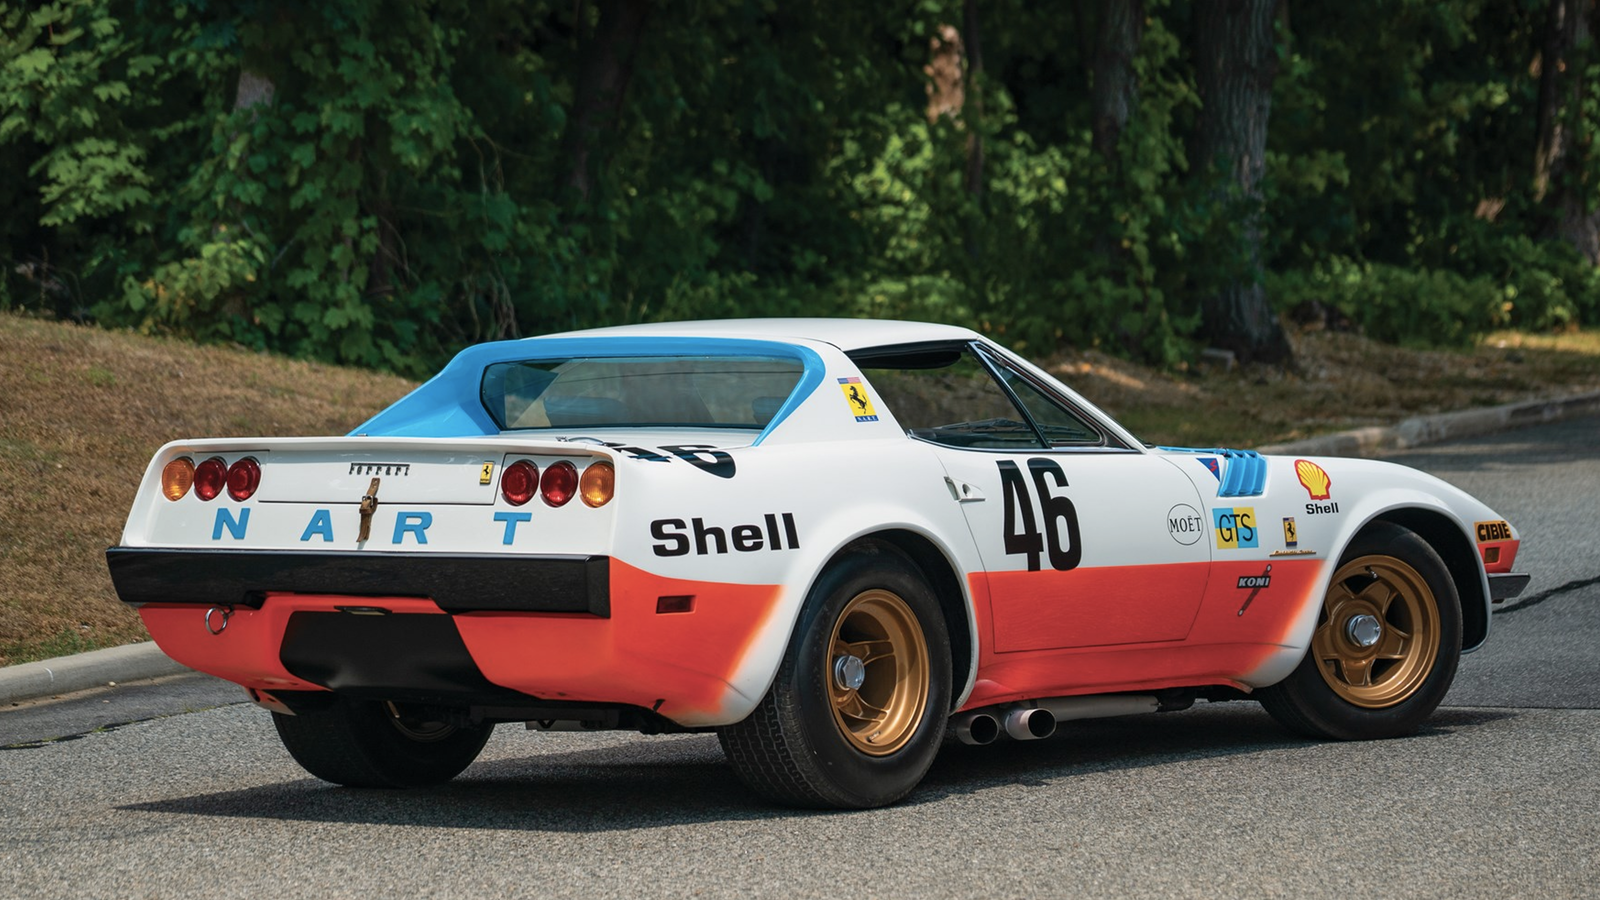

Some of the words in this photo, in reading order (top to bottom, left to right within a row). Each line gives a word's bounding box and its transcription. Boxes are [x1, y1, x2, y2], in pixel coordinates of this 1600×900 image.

[995, 457, 1082, 572] 46
[1305, 502, 1339, 515] Shell
[650, 513, 800, 557] Shell
[1219, 513, 1254, 542] GTS
[1238, 577, 1270, 587] KONI
